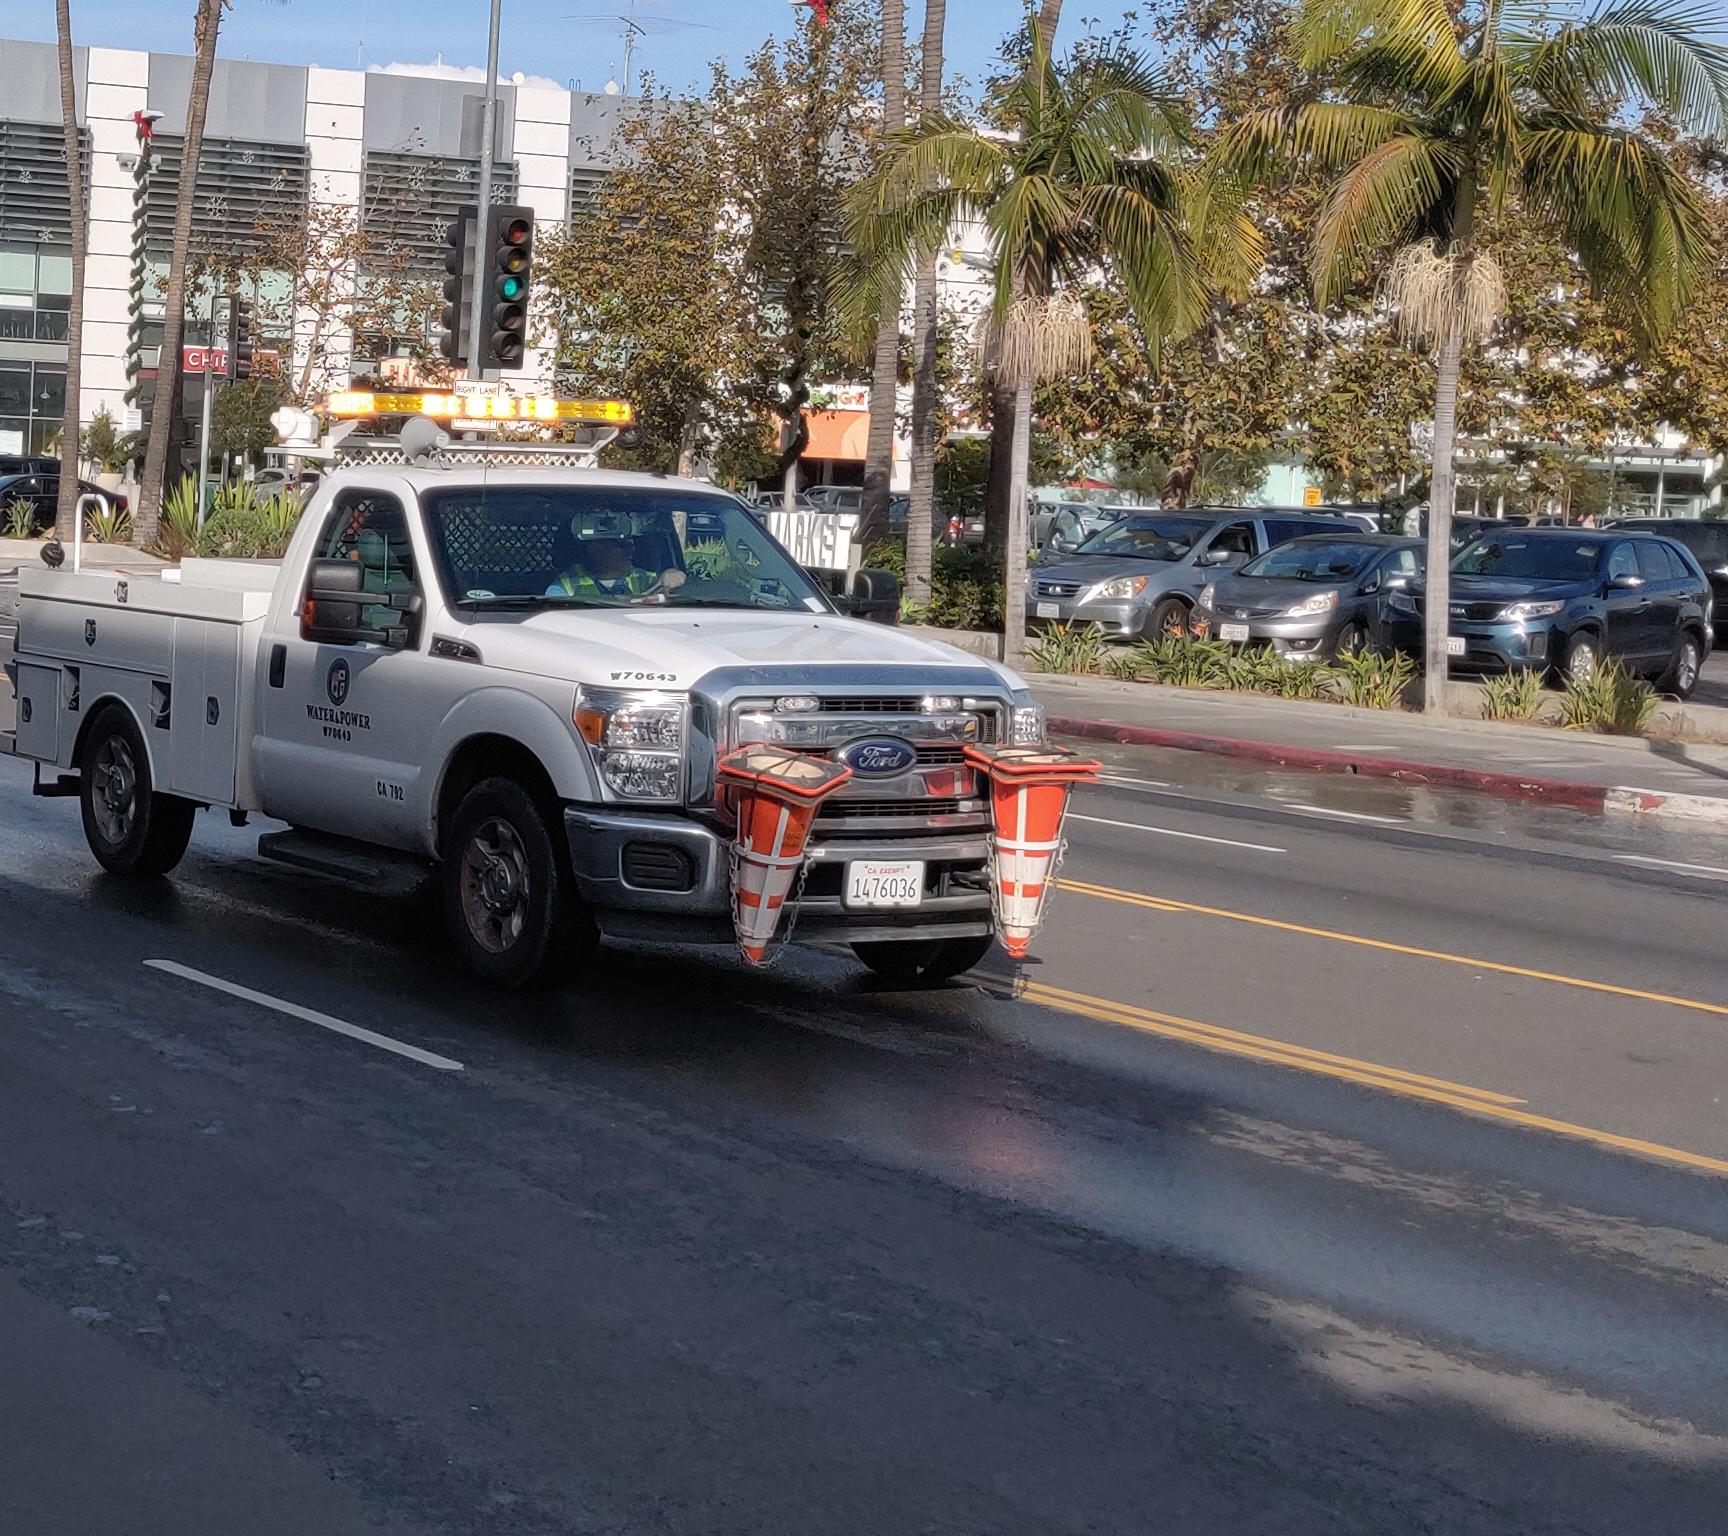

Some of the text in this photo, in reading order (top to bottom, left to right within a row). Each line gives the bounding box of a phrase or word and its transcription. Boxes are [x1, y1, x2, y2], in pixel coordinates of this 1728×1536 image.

[456, 386, 497, 395] RIGHT LANE
[769, 512, 858, 569] ARKET
[610, 671, 677, 681] W70643
[858, 745, 902, 768] Ford
[377, 780, 387, 797] CA
[879, 867, 906, 875] EXEMPT
[853, 877, 917, 898] 1476036
